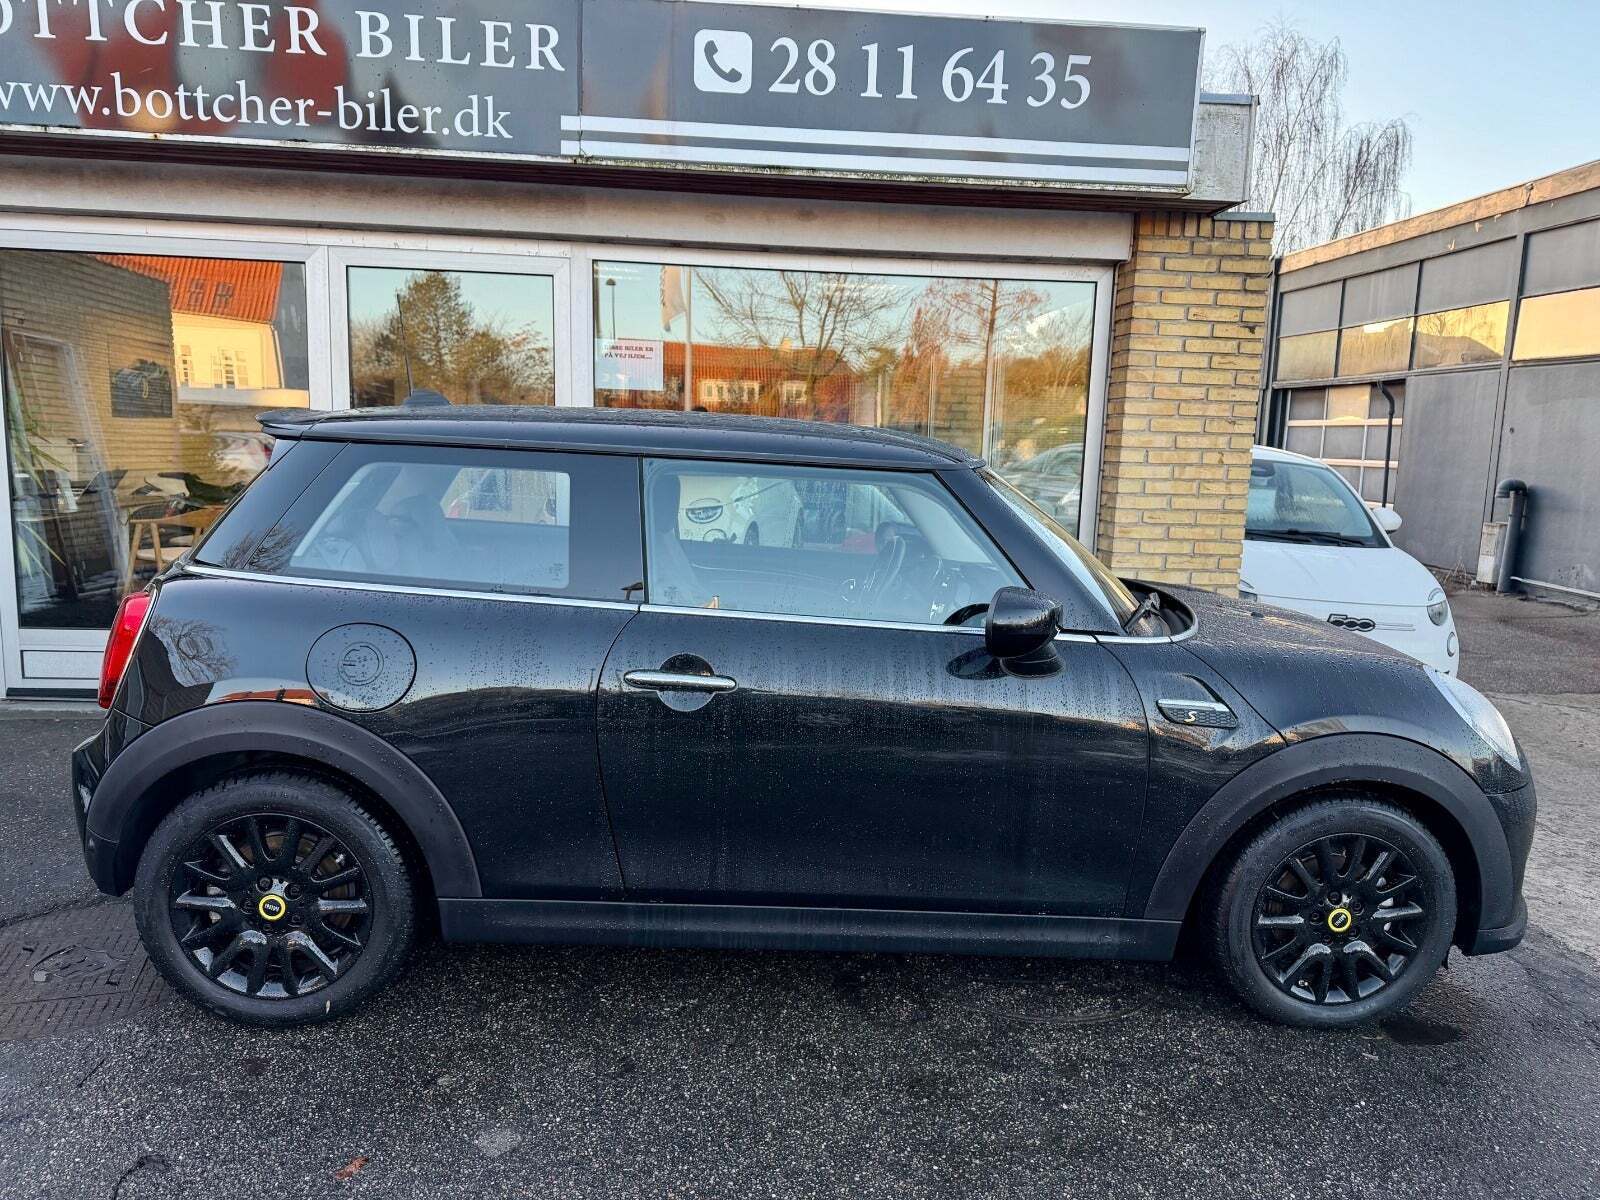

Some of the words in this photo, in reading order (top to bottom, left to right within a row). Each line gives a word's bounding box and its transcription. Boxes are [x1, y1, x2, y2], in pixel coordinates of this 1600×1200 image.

[0, 0, 327, 56] TTCHER
[355, 9, 566, 72] BILER
[770, 37, 836, 97] 28
[861, 43, 919, 99] 11
[942, 47, 1009, 104] 64
[1027, 52, 1092, 110] 35
[1327, 613, 1376, 632] 500
[1184, 710, 1198, 723] S
